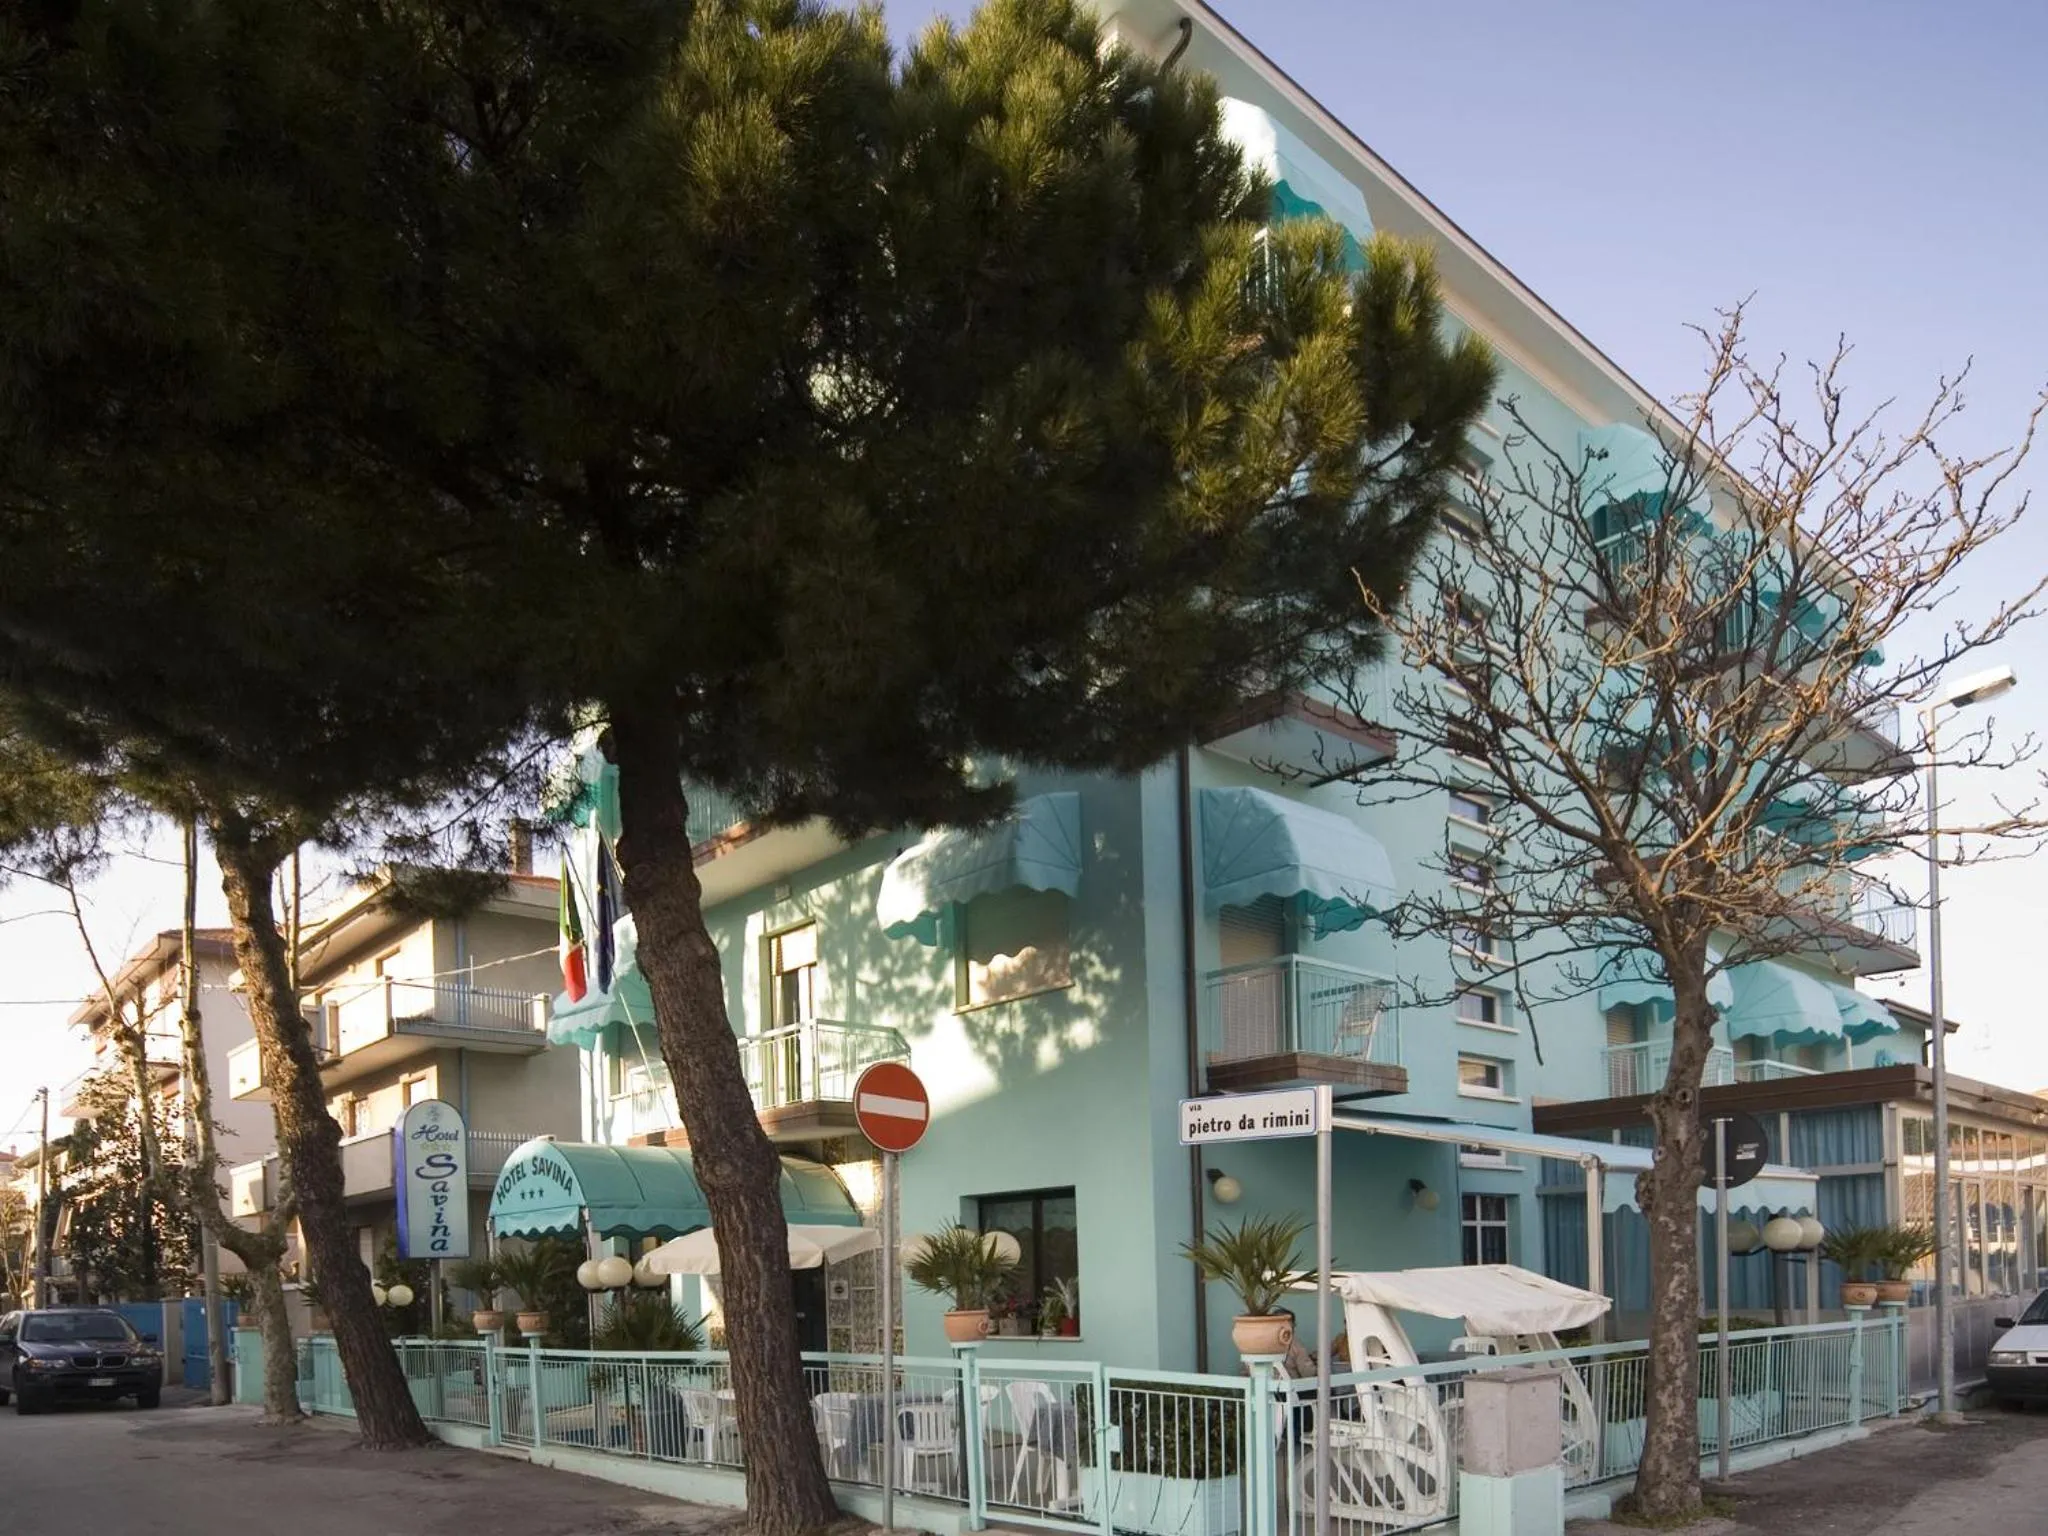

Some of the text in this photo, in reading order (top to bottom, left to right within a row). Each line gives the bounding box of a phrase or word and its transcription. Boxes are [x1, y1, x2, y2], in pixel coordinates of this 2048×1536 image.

[1189, 1104, 1202, 1112] via
[411, 1124, 459, 1142] Hotel
[1189, 1109, 1310, 1137] pietro da rimini
[496, 1156, 574, 1204] HOTEL SAVINA
[415, 1153, 459, 1252] Savina
